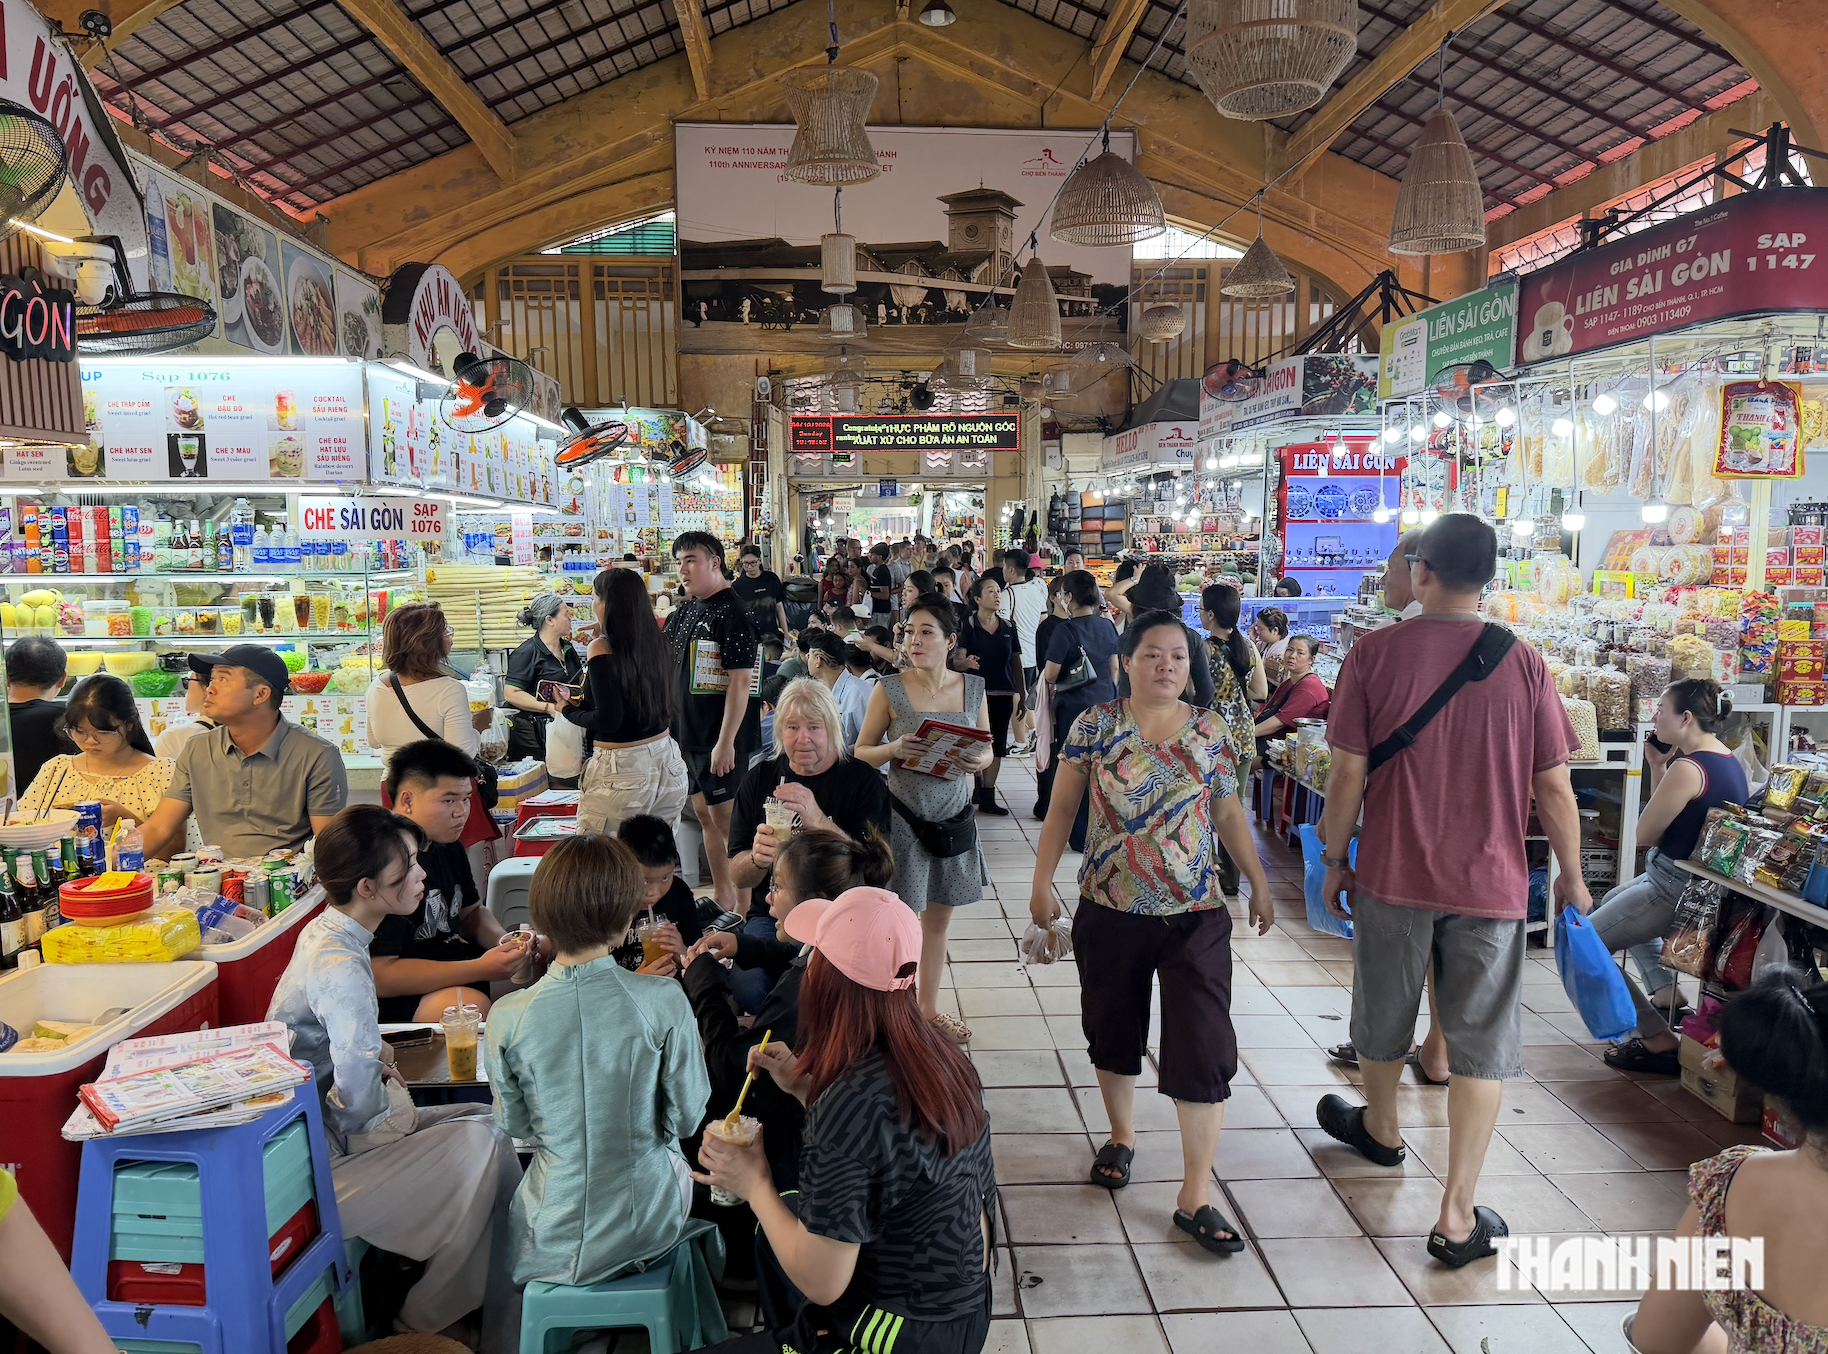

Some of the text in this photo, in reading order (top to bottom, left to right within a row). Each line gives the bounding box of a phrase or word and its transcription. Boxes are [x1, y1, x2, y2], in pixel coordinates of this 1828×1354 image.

[718, 146, 740, 156] NIỆM
[741, 147, 755, 155] 110
[757, 146, 774, 155] NĂM
[874, 149, 897, 159] HÀNH
[709, 160, 787, 169] 110th ANNIVERSAR
[1756, 232, 1807, 253] SẠP
[1609, 234, 1698, 276] GIA ĐÌNH G7
[1575, 248, 1731, 316] LIÊN SÀI GÒN
[414, 281, 436, 352] KHU
[435, 269, 451, 319] ĂN
[1429, 292, 1515, 342] LIÊN SÀI GÒN
[1584, 315, 1599, 330] SẠP
[1623, 303, 1643, 319] 1189
[1709, 285, 1724, 296] HCM
[1636, 314, 1658, 329] 0903
[1659, 304, 1692, 323] 113409
[1495, 327, 1509, 339] CAFE
[142, 371, 231, 383] Sạp 1076
[139, 446, 153, 454] SEN
[895, 435, 917, 445] CHO
[1115, 430, 1138, 456] HELLO
[230, 447, 235, 455] 3
[1292, 448, 1331, 470] LIÊN
[304, 502, 404, 531] CHÈ SÀI GÒN
[413, 502, 438, 519] SẠP
[411, 519, 442, 534] 1076
